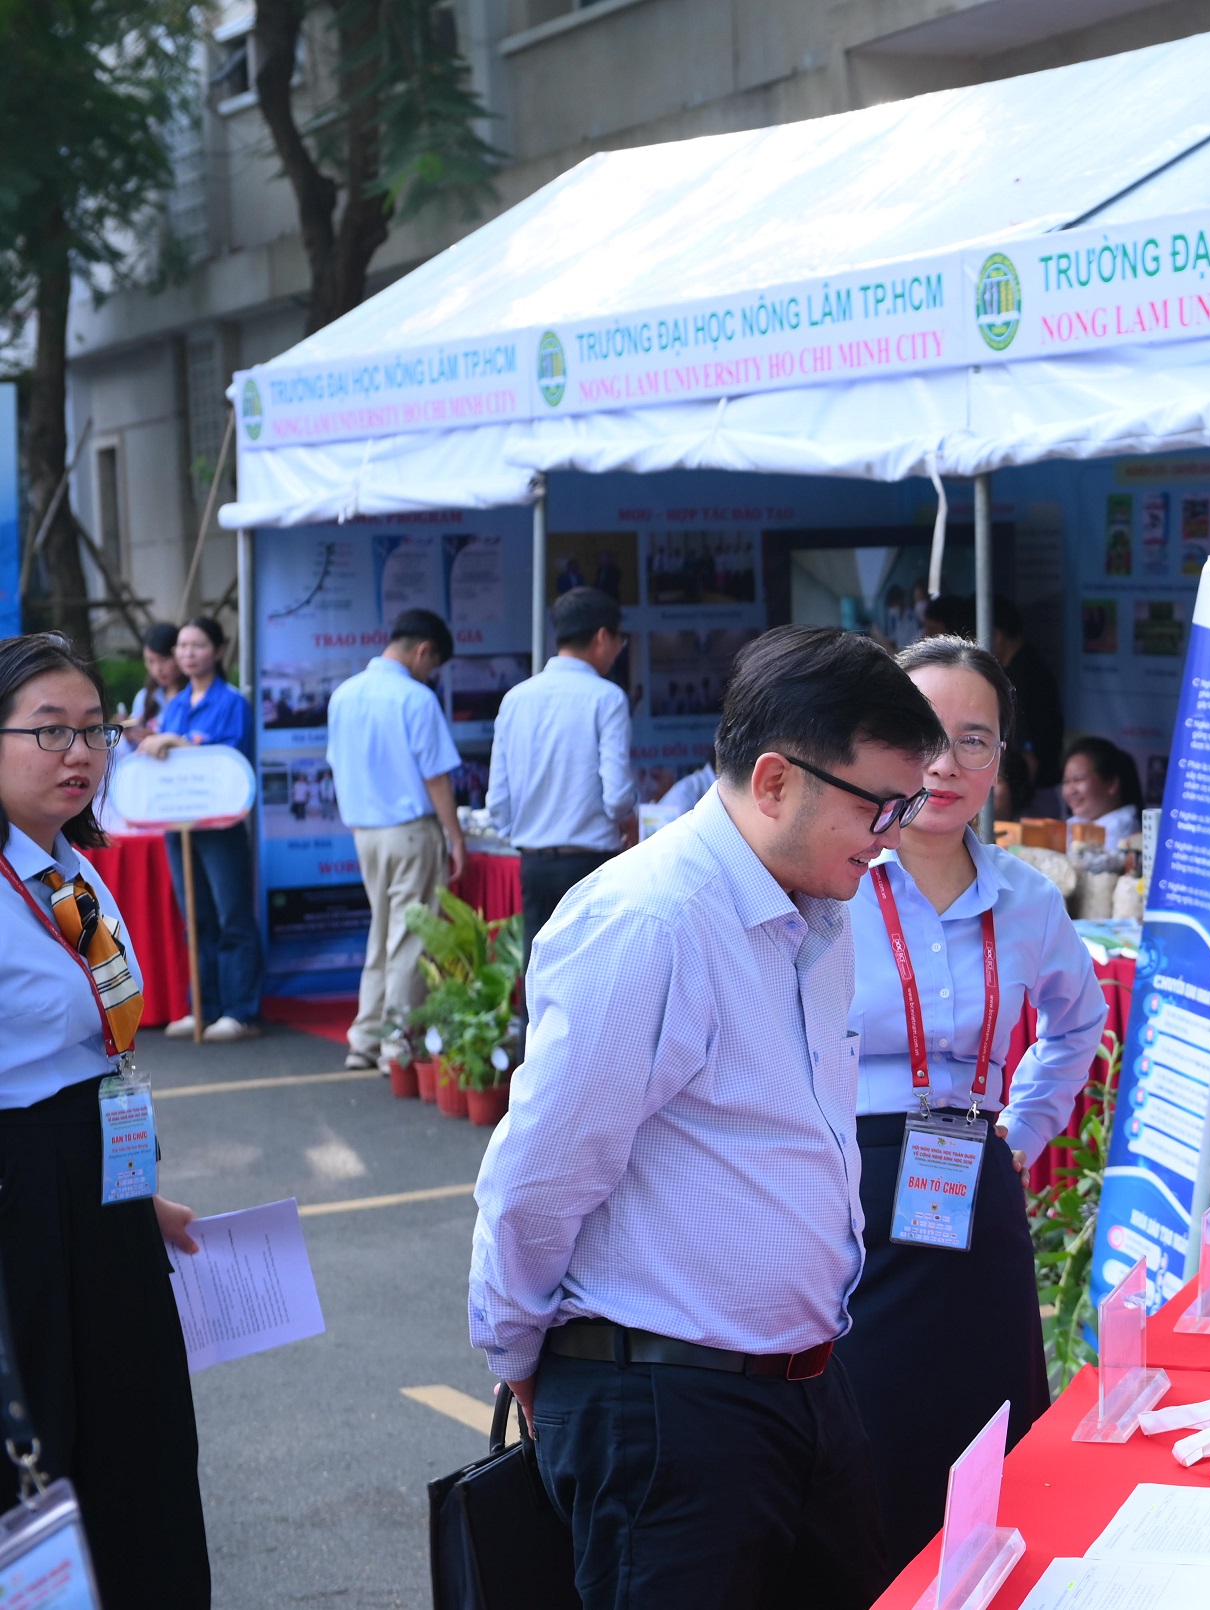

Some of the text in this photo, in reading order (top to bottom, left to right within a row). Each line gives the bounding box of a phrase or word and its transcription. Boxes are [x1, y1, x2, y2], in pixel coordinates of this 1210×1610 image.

[1040, 234, 1160, 293] TRƯỜNG
[576, 272, 944, 363] TRƯỜNG ĐẠI HỌC NÔNG LÂM TP.HCM
[1040, 307, 1108, 345] NONG
[1115, 299, 1171, 337] LAM
[269, 344, 517, 406] TRƯỜNG ĐẠI HỌC NÔNG LÂM TP.HCM
[579, 330, 946, 403] NONG LAM UNIVERSITY HO CHI MINH CITY
[272, 389, 516, 437] NONG LAM UNIVERSITY HO CHI MINH CITY
[312, 632, 356, 648] TRAO
[908, 1175, 967, 1197] BAN TỔ CHỨC
